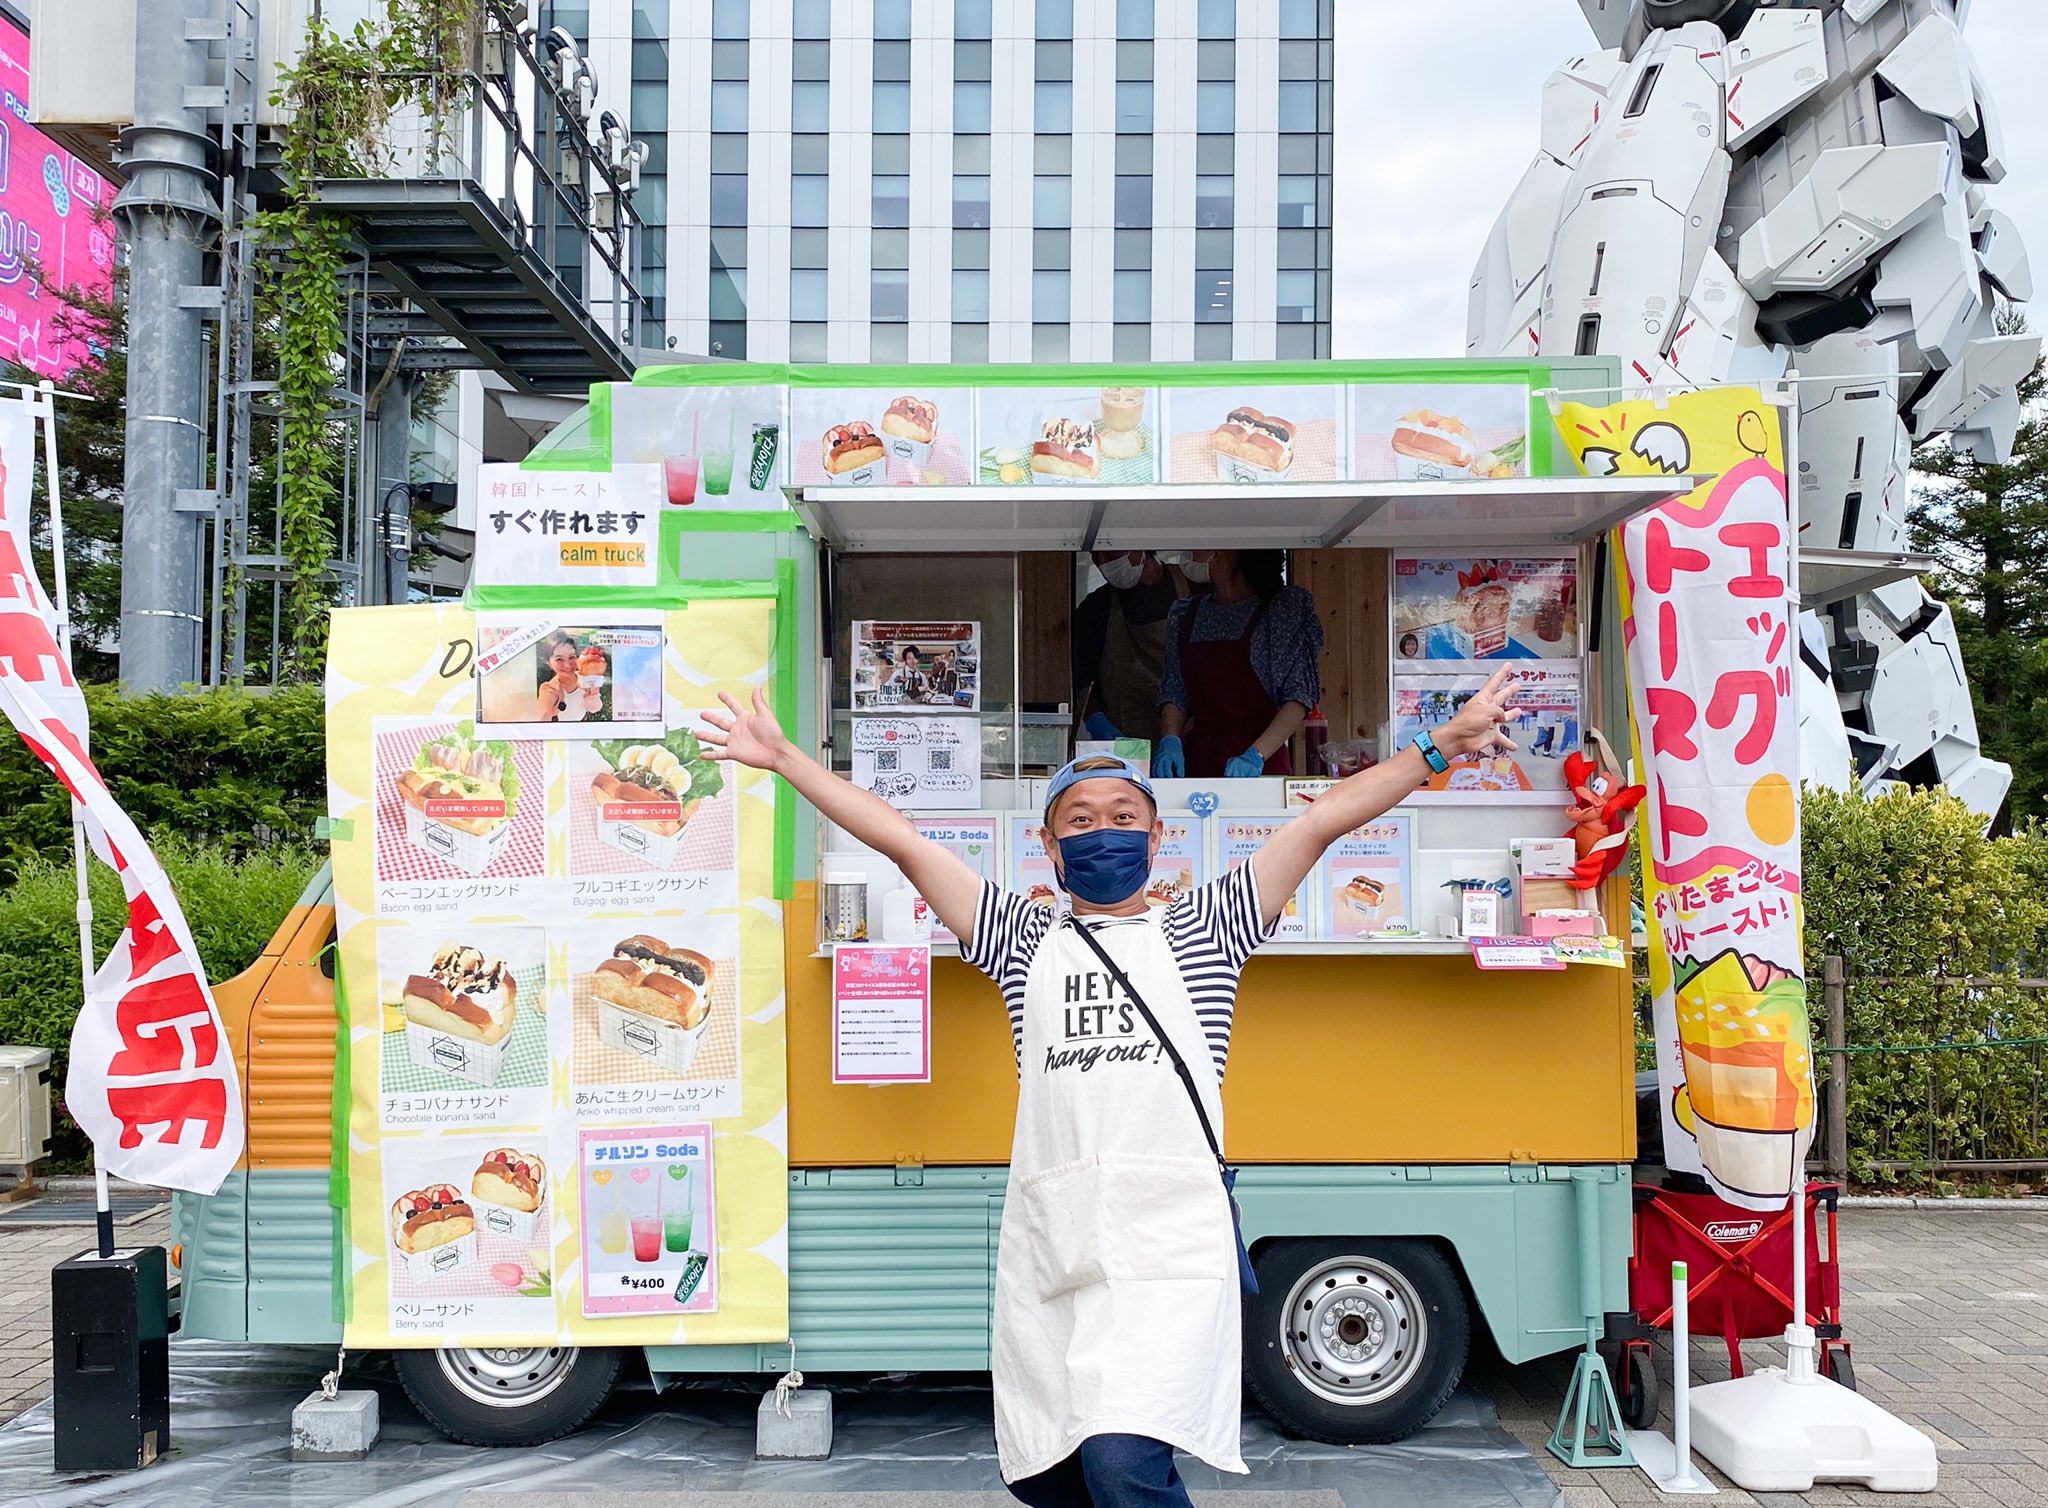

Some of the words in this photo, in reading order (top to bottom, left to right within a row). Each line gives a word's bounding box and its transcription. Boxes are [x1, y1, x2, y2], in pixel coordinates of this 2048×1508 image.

[491, 482, 607, 498] 韓国トースト
[489, 509, 645, 535] すぐ作れます
[561, 546, 597, 561] calm
[604, 545, 645, 561] truck
[1705, 522, 1791, 765] エッグ
[1645, 517, 1711, 861] トースト
[1205, 796, 1215, 810] 2
[960, 830, 989, 840] Soda
[1347, 828, 1398, 836] こホイップ
[381, 883, 520, 900] ベーコンエッグサンド
[381, 903, 410, 913] Bacon
[413, 904, 432, 914] egg
[436, 901, 458, 911] sand
[573, 896, 608, 907] Bulgogi
[611, 897, 630, 906] egg
[632, 895, 655, 904] sand
[1282, 924, 1303, 932] ¥700
[1044, 1045, 1106, 1074] hang
[1106, 1039, 1163, 1065] out!
[575, 1085, 726, 1104] あんこ生クリームサンド
[385, 1094, 510, 1112] チョコバナナサンド
[576, 1107, 600, 1116] Anko
[604, 1105, 643, 1115] whipped
[646, 1105, 675, 1113] cream
[678, 1103, 700, 1112] sand
[385, 1114, 432, 1124] Chocolate
[436, 1113, 470, 1122] banana
[473, 1111, 496, 1120] sand
[594, 1145, 649, 1160] チルソン
[655, 1143, 699, 1158] Soda
[1707, 1224, 1749, 1237] Coleman
[395, 1303, 475, 1317] ベリーサンド
[395, 1319, 419, 1329] Berry
[422, 1319, 444, 1328] sand
